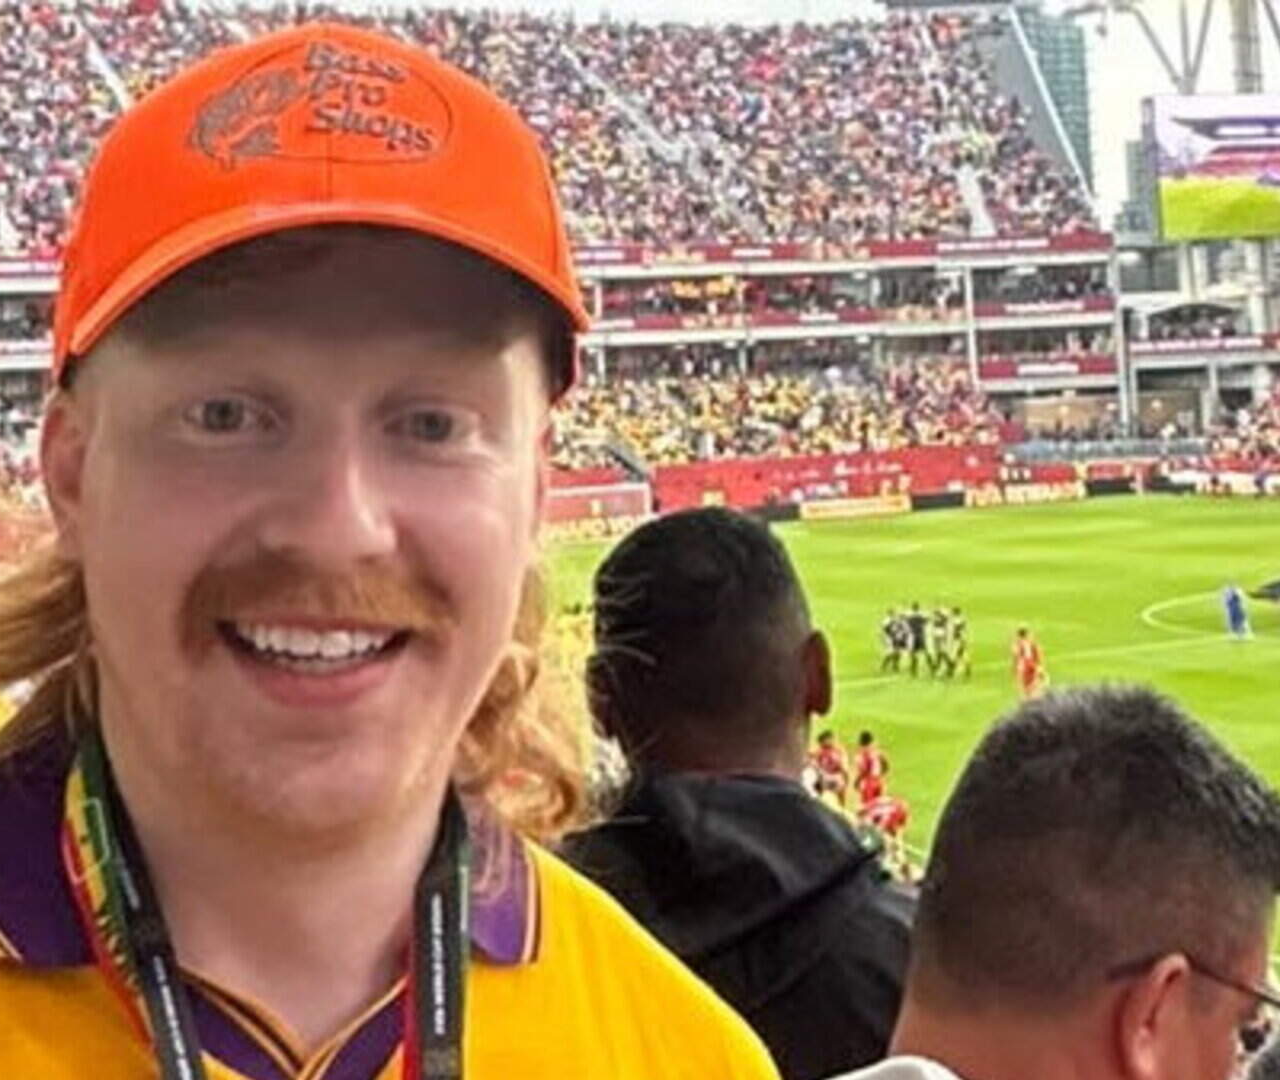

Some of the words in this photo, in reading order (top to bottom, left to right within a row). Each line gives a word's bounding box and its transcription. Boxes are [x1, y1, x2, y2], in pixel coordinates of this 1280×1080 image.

[304, 42, 406, 83] Bass
[307, 72, 386, 106] Pro
[304, 102, 434, 151] Shops
